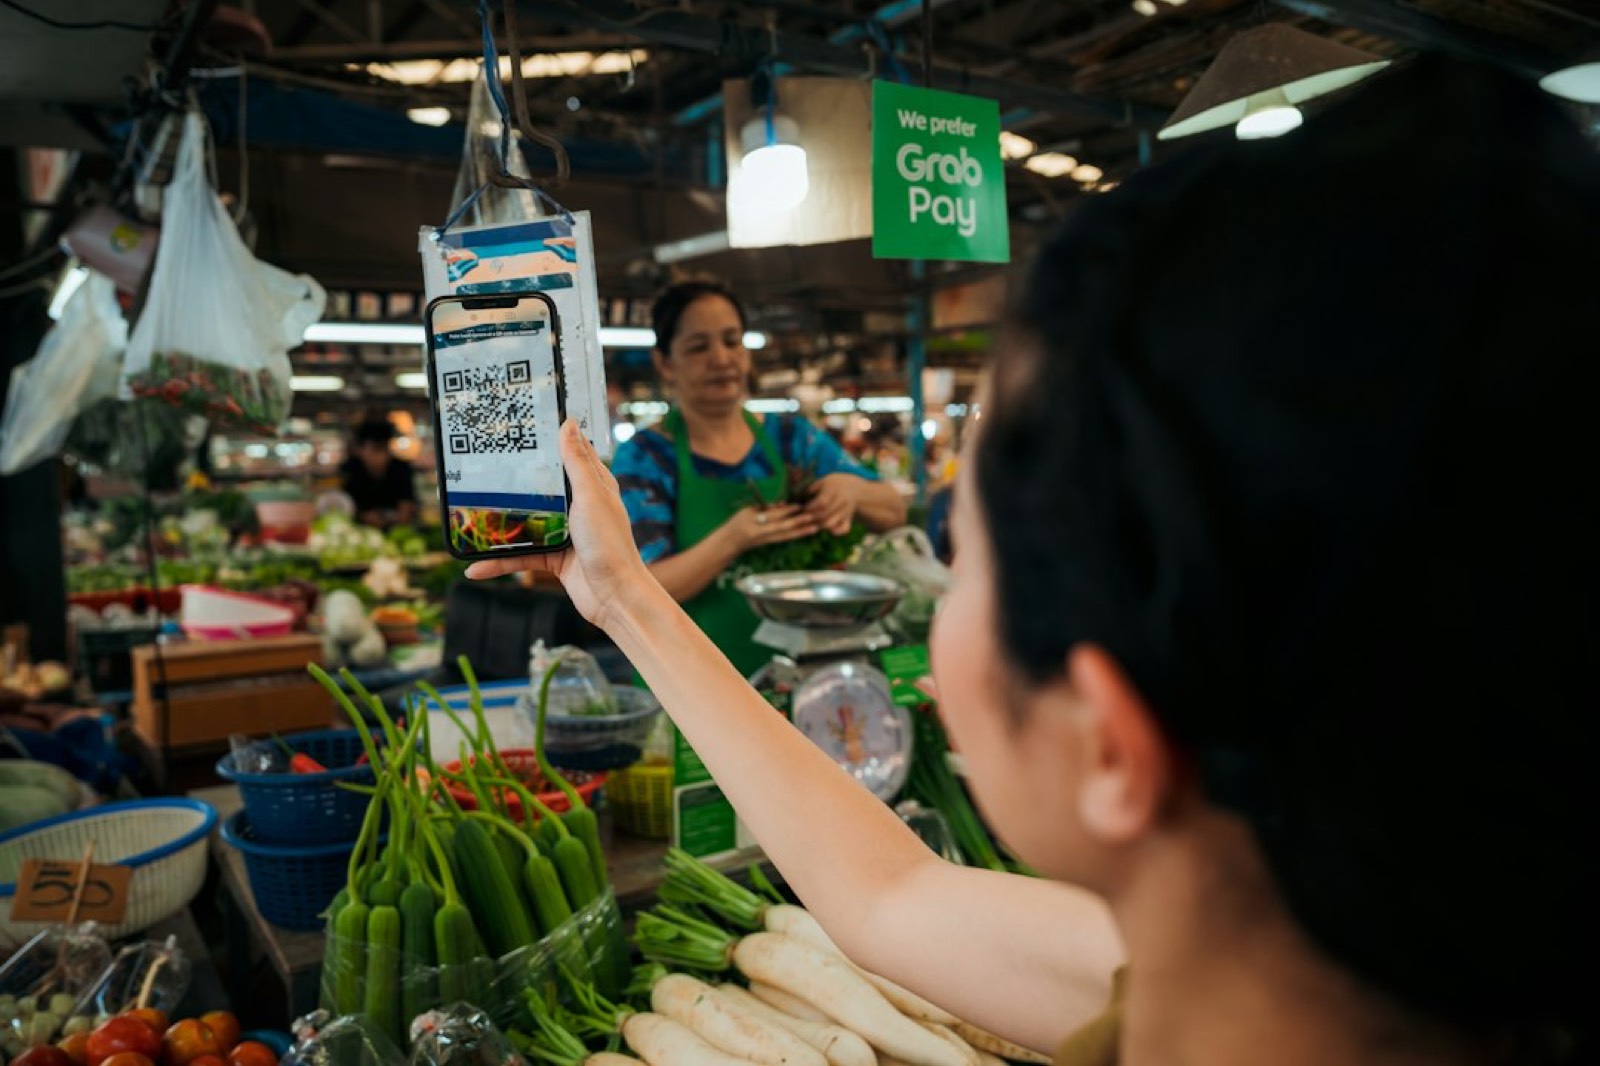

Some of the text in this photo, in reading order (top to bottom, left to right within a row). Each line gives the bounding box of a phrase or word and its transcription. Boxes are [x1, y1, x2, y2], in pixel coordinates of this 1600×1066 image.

[897, 109, 977, 137] We prefer
[896, 142, 982, 187] Grab
[909, 186, 976, 237] Pay
